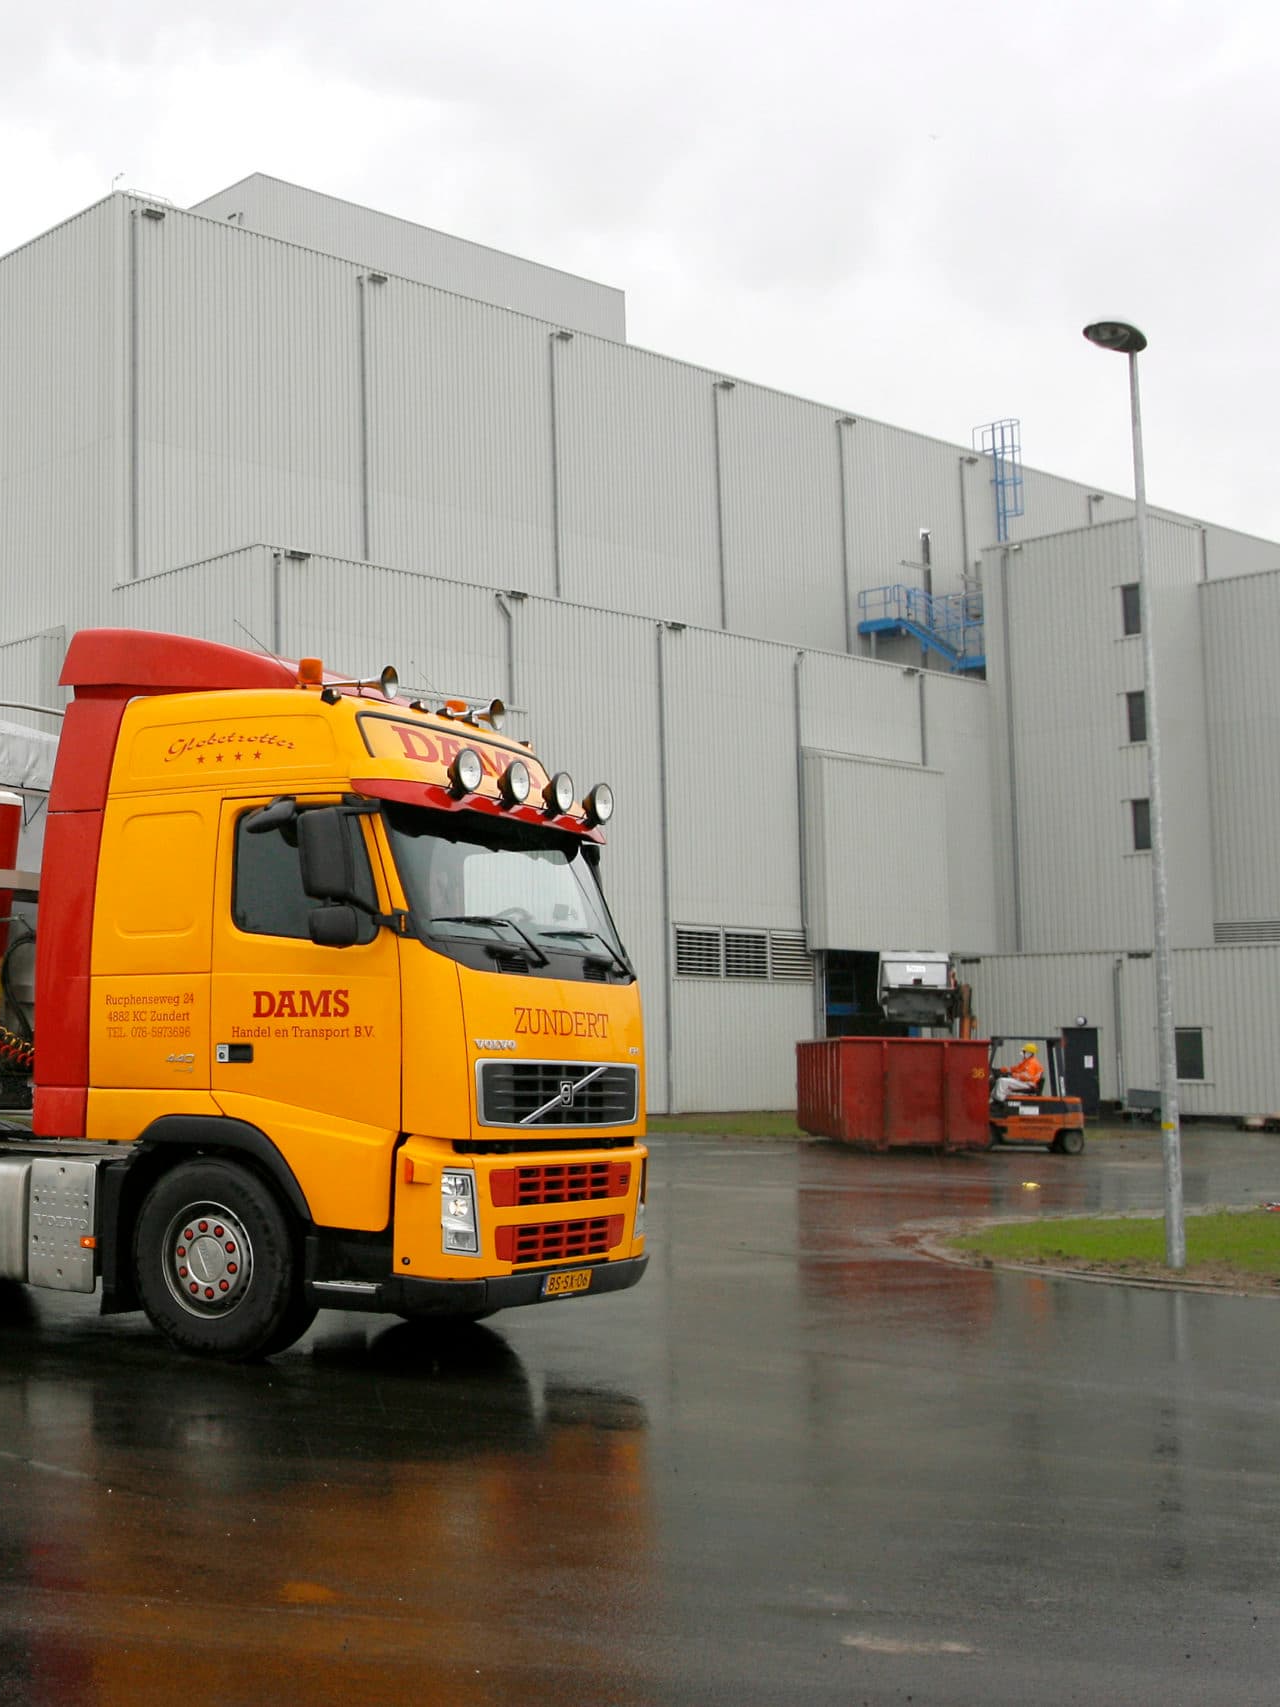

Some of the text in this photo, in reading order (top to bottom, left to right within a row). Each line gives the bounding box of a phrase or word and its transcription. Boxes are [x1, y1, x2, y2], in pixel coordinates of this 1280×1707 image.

[164, 732, 295, 762] Globetrotter
[105, 992, 194, 1007] Rucphenseweg 24
[253, 989, 350, 1018] DAMS
[133, 1010, 147, 1022] KC
[150, 1010, 190, 1022] Zundert
[514, 1007, 609, 1039] ZUNDERT
[232, 1026, 376, 1040] Handel en Transport B.V.
[474, 1039, 517, 1050] VOLVO
